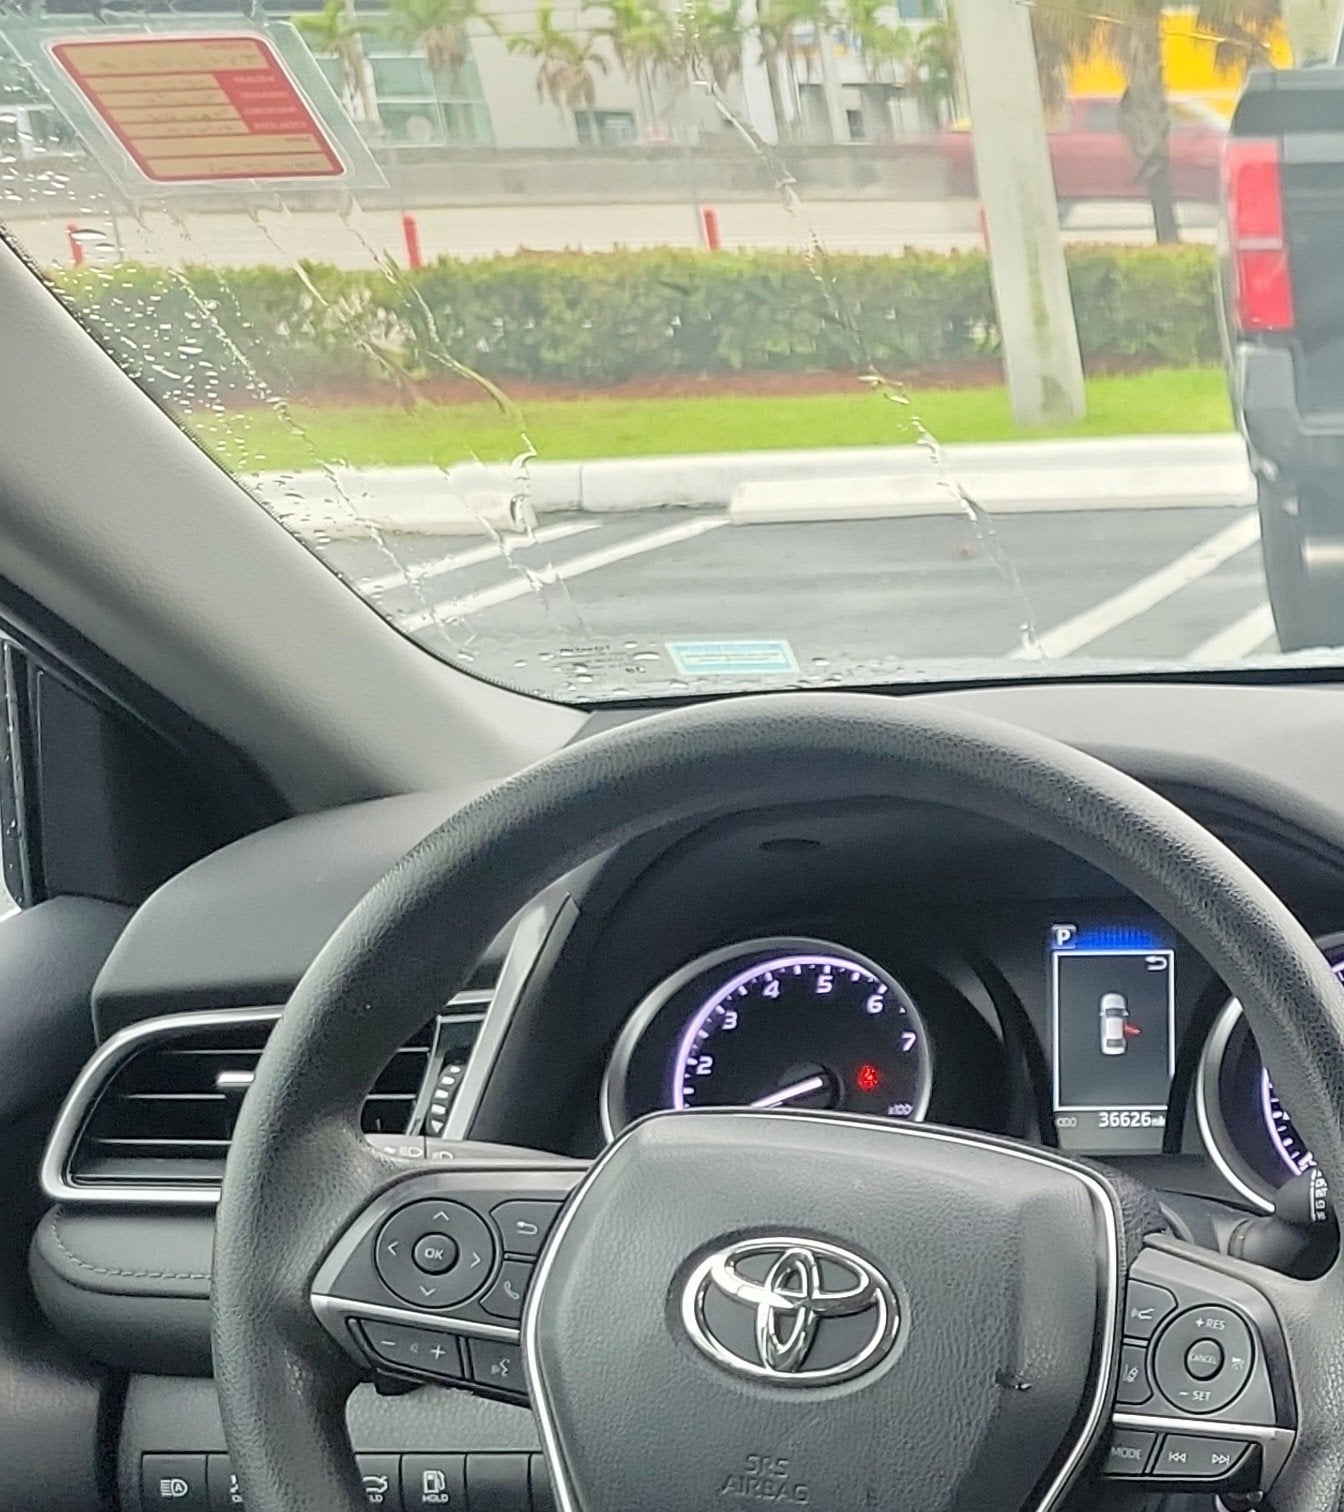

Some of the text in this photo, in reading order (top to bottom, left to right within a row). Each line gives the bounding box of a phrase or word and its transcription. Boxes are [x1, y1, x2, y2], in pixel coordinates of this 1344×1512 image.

[1057, 929, 1070, 946] P
[761, 979, 780, 999] 4
[815, 974, 833, 995] 5
[867, 995, 883, 1014] 6
[720, 1010, 738, 1030] 3
[901, 1032, 917, 1051] 7
[696, 1057, 713, 1075] 2
[1098, 1111, 1151, 1127] 36626
[425, 1248, 445, 1260] OK
[1205, 1318, 1226, 1331] RES
[1189, 1353, 1217, 1365] CANCEL
[1193, 1391, 1211, 1401] SET
[1111, 1446, 1142, 1459] MODE
[422, 1494, 449, 1503] HOLD
